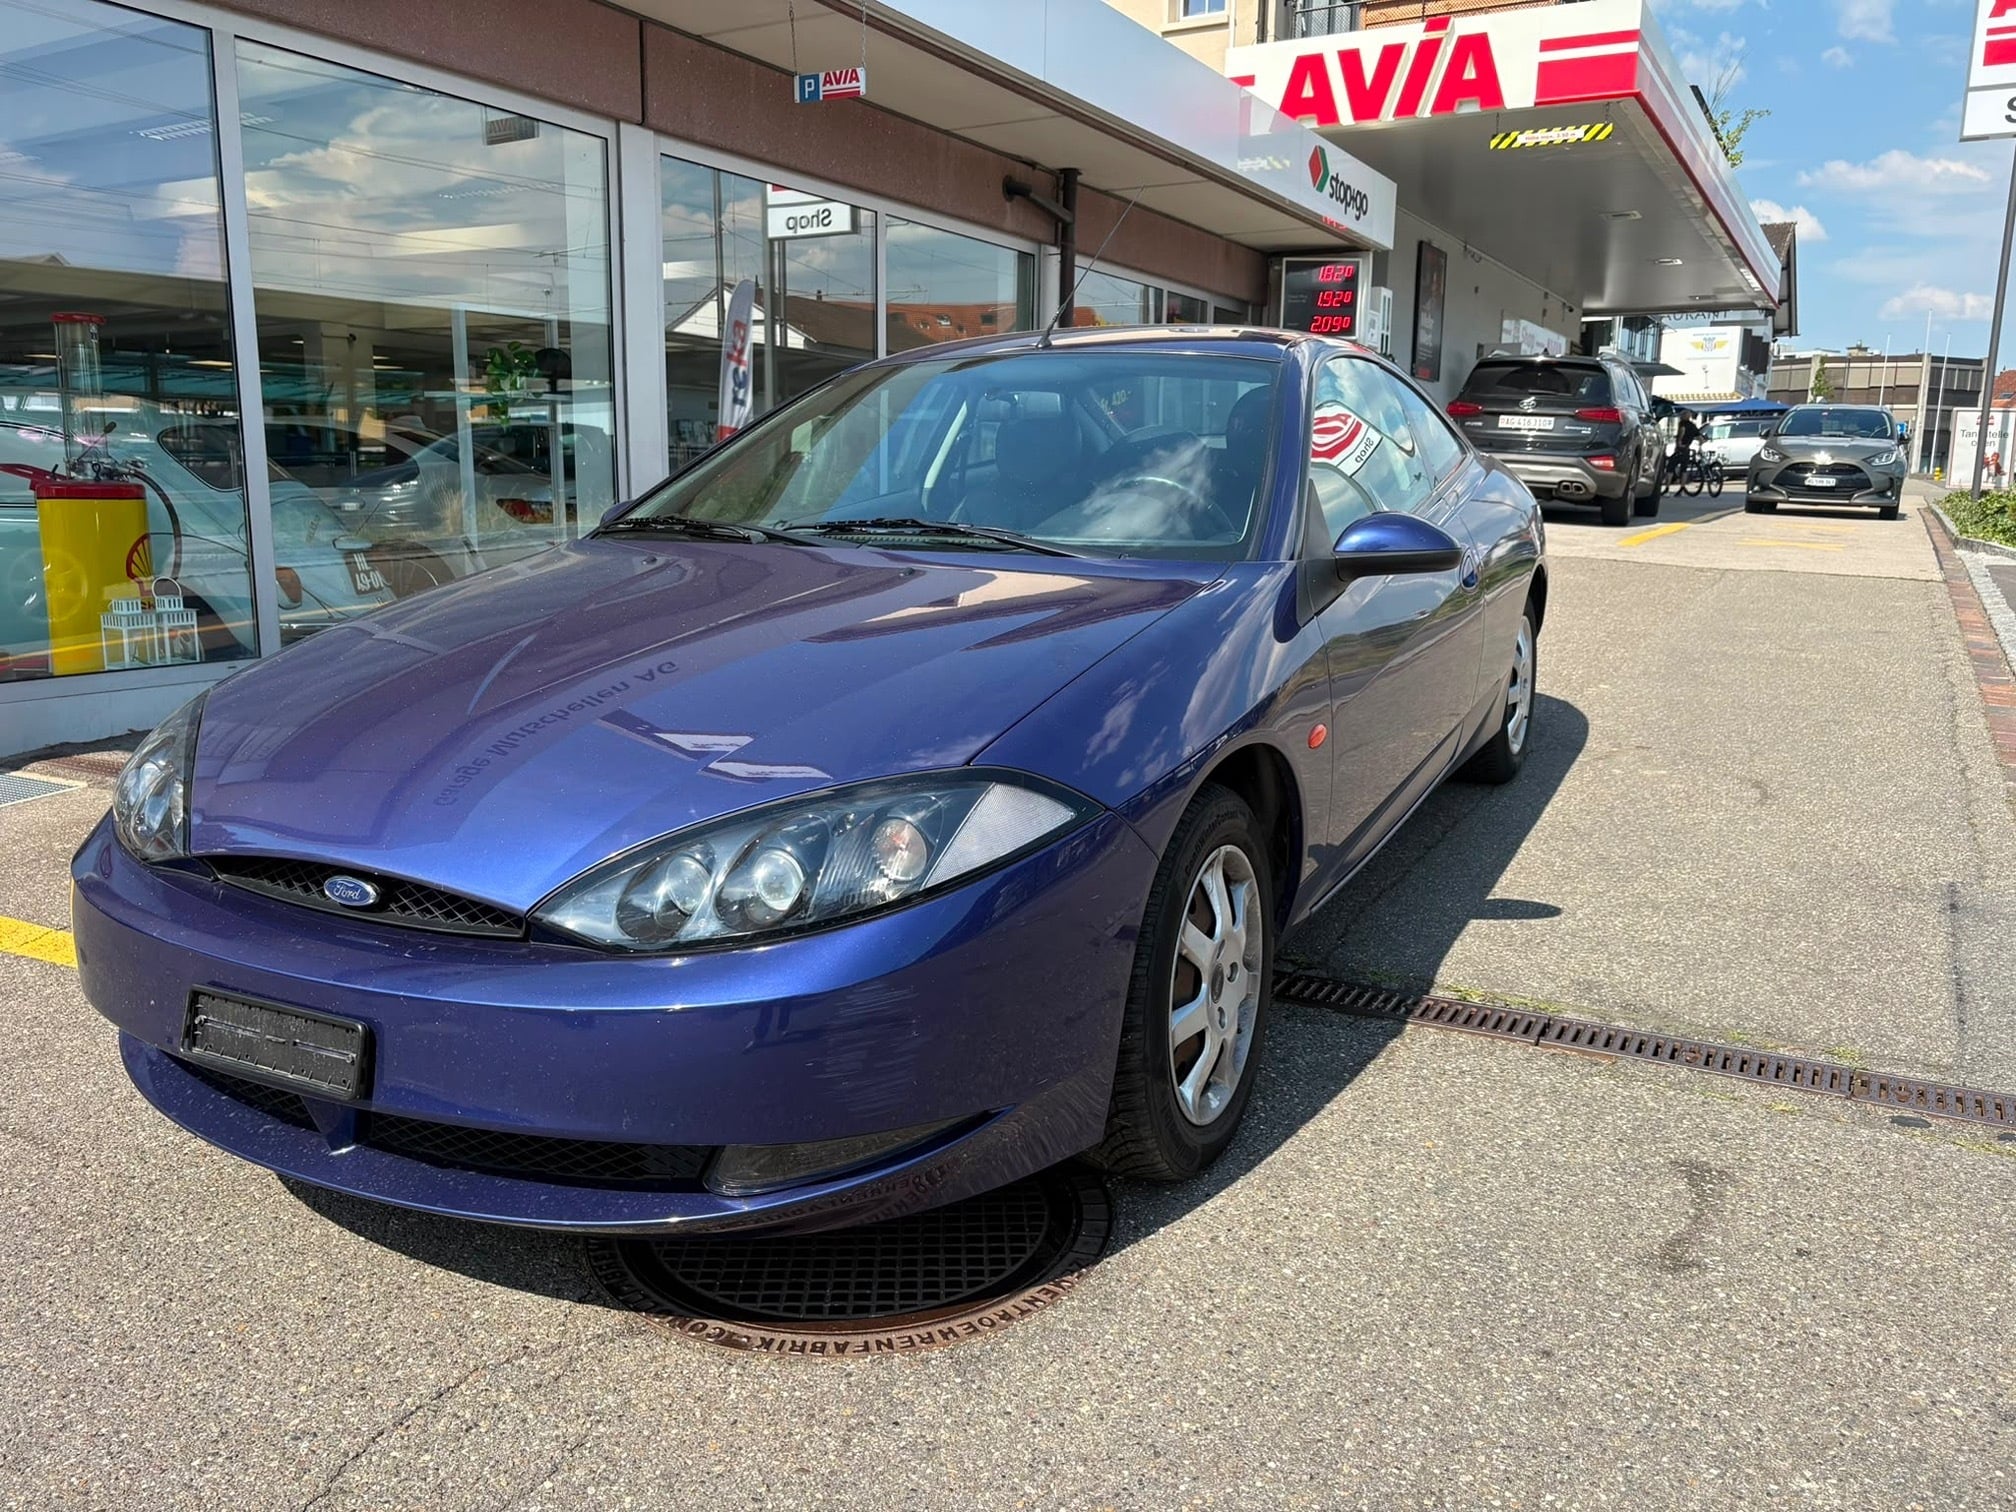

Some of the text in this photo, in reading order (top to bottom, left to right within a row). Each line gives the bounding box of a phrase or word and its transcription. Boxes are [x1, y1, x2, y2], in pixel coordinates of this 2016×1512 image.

[822, 68, 861, 87] AVIA
[1328, 172, 1369, 221] stop+go
[1960, 429, 2009, 439] Tantelle
[333, 880, 361, 900] Ford
